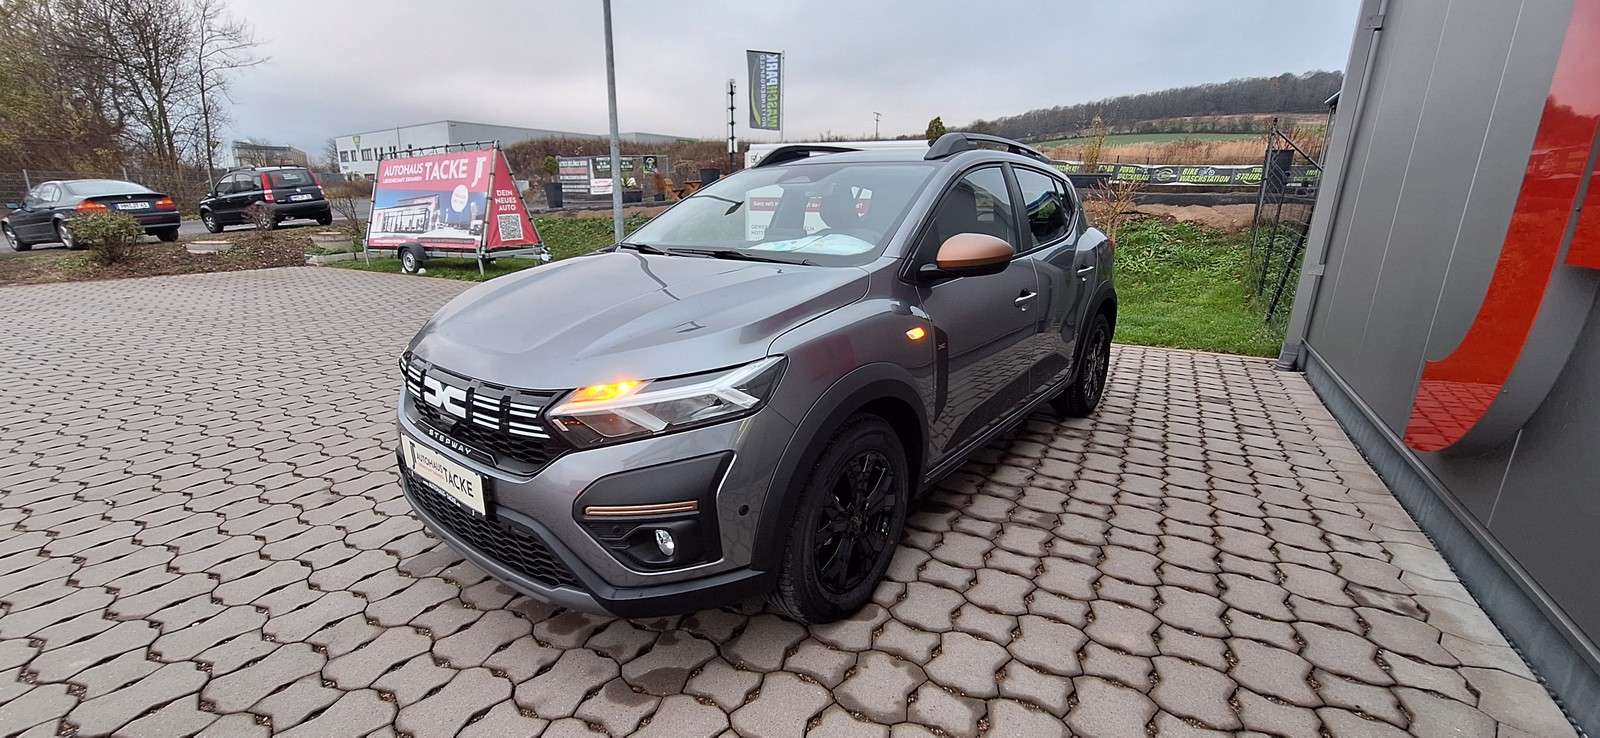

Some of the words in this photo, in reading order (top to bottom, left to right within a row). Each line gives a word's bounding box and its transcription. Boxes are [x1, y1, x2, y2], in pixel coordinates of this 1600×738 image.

[384, 163, 423, 177] AUTOHAUS
[424, 158, 468, 181] TACKE
[1179, 175, 1231, 183] WASCHSTATION
[1182, 167, 1199, 175] BIKE
[428, 428, 472, 455] STEPWAY
[416, 452, 444, 474] AUTOHAUS
[443, 466, 474, 498] TACKE
